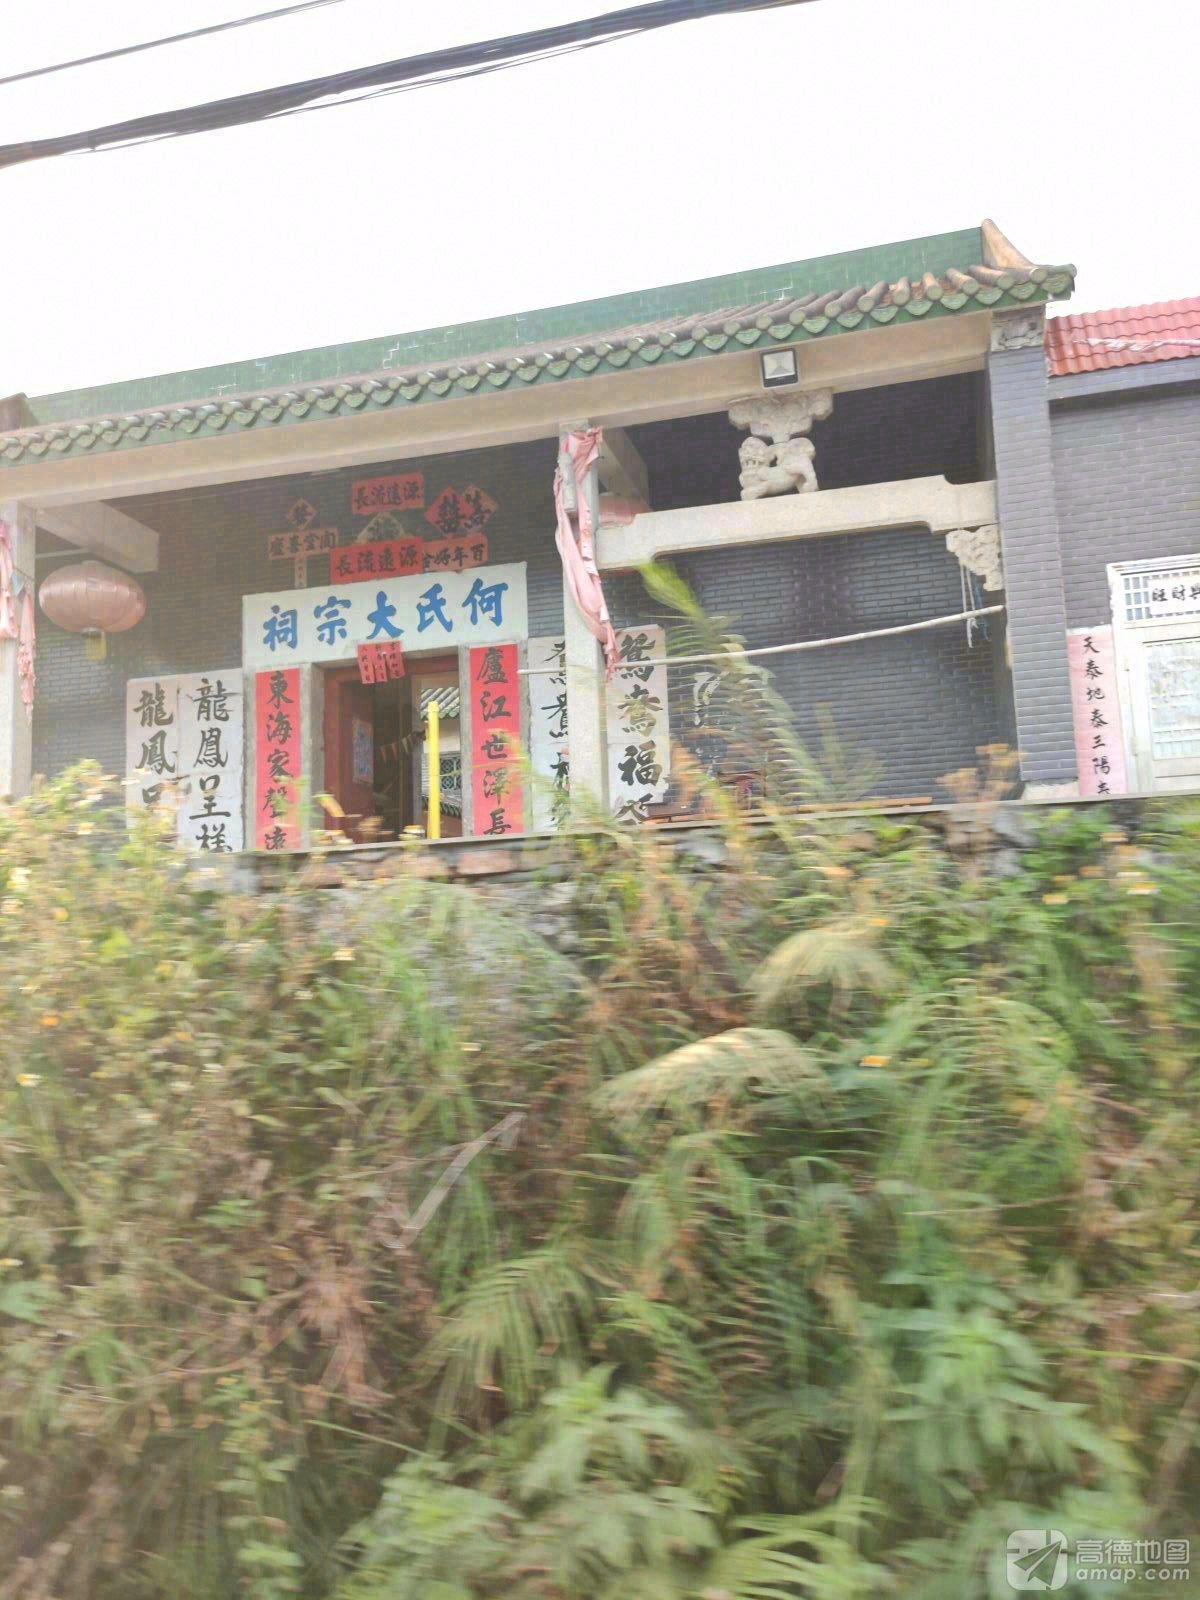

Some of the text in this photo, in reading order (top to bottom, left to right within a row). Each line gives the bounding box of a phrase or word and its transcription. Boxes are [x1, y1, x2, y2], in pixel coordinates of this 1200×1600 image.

[335, 544, 419, 577] 源遠流長
[262, 577, 509, 652] 何氏大宗祠
